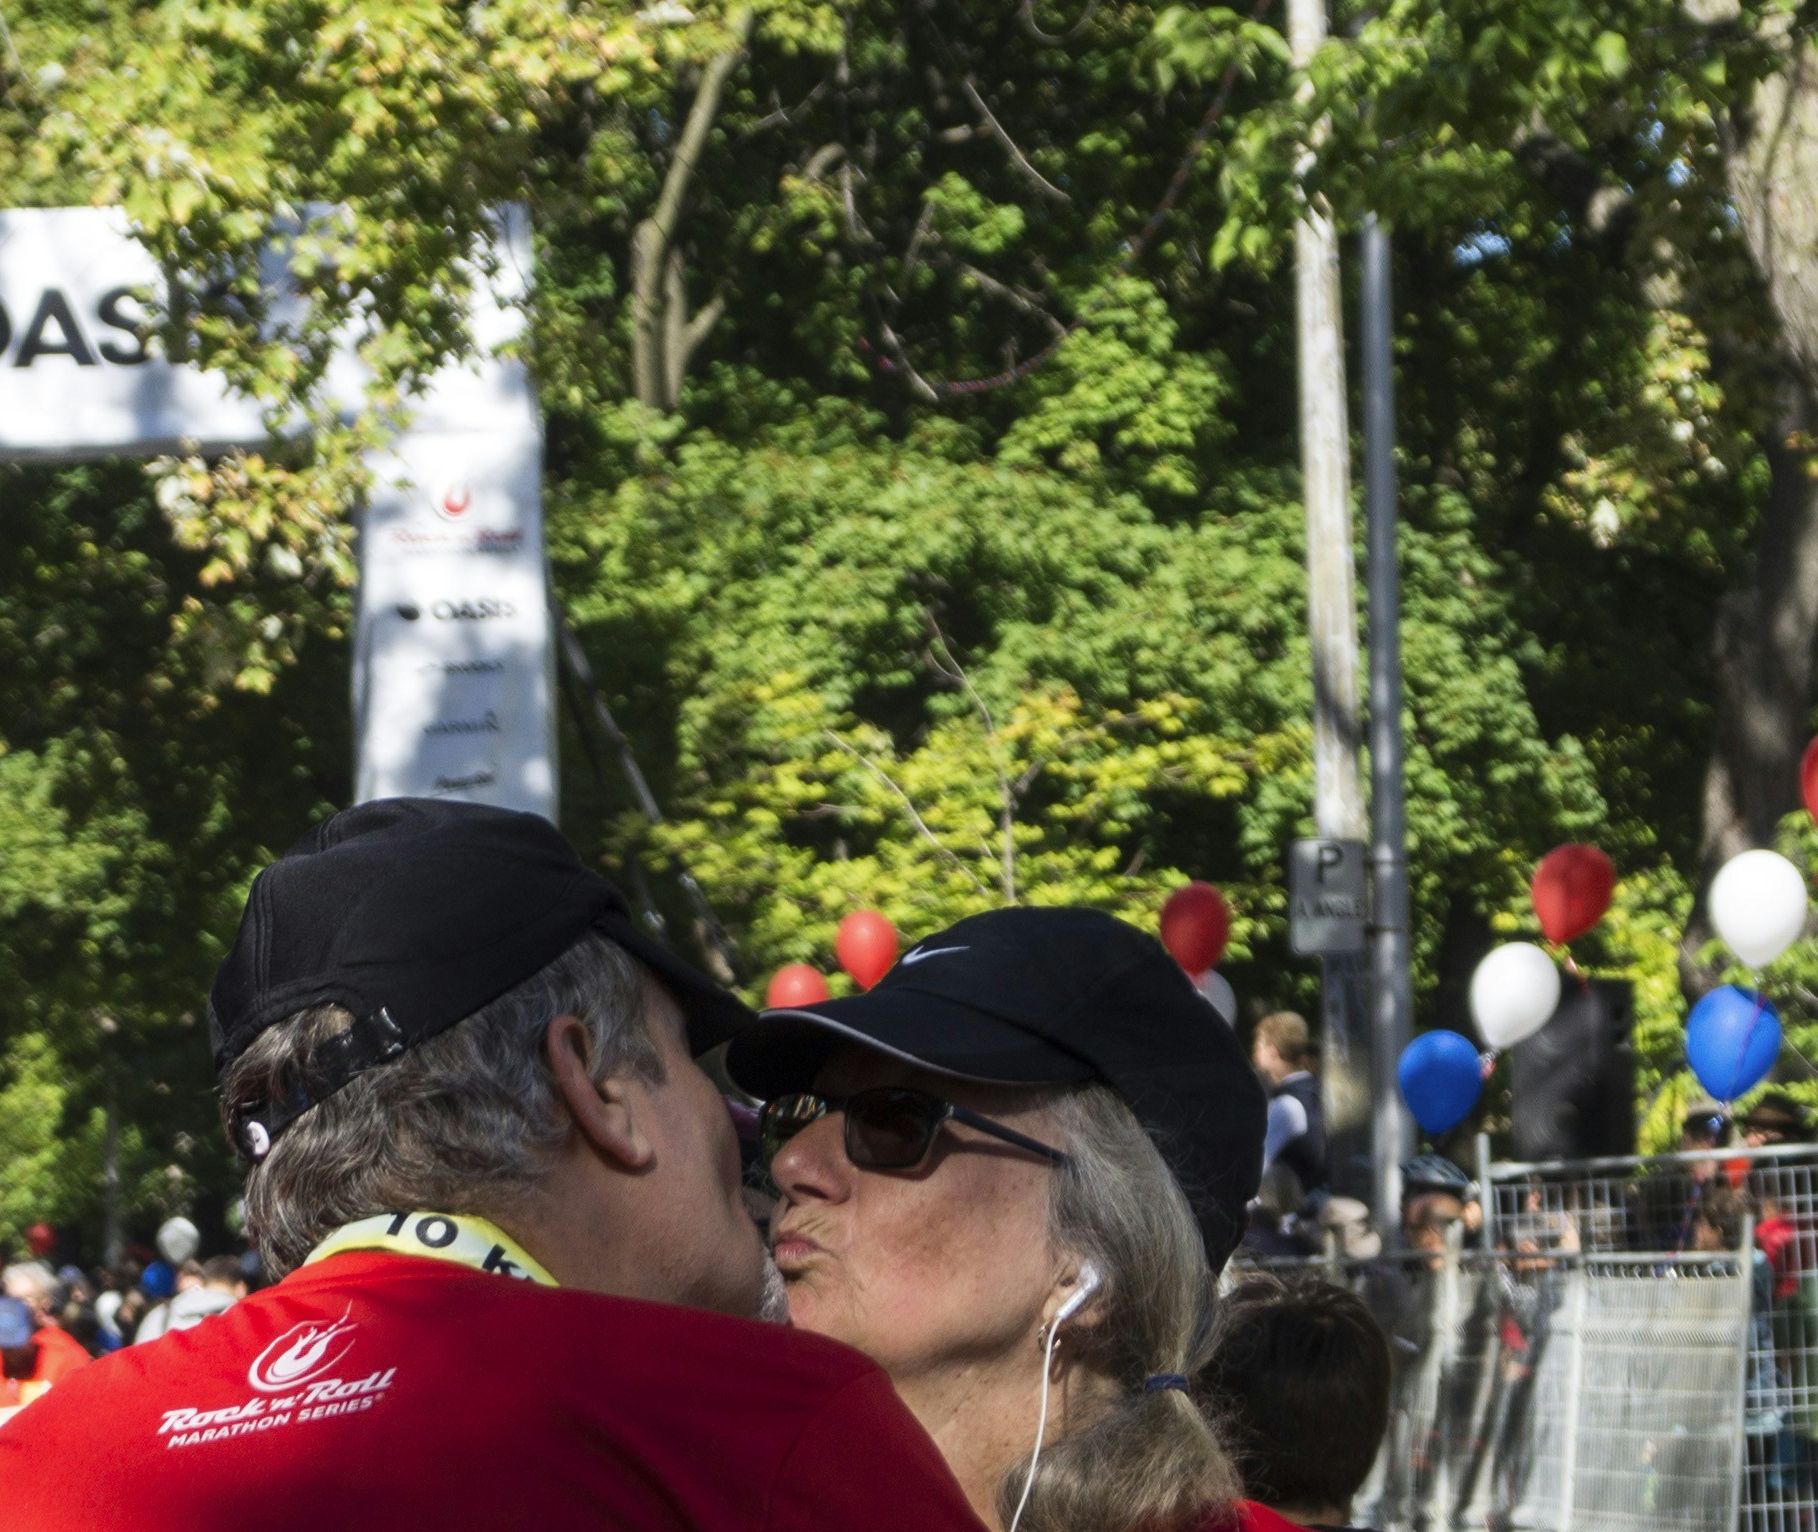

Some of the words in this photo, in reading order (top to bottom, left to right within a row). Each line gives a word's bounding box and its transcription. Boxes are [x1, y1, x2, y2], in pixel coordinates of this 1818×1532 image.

[1317, 845, 1344, 884] P
[383, 1212, 459, 1249] 10
[157, 1398, 269, 1436] Rock
[299, 1366, 398, 1405] Roll
[166, 1411, 291, 1450] MARATHON
[296, 1396, 375, 1424] SERIES
